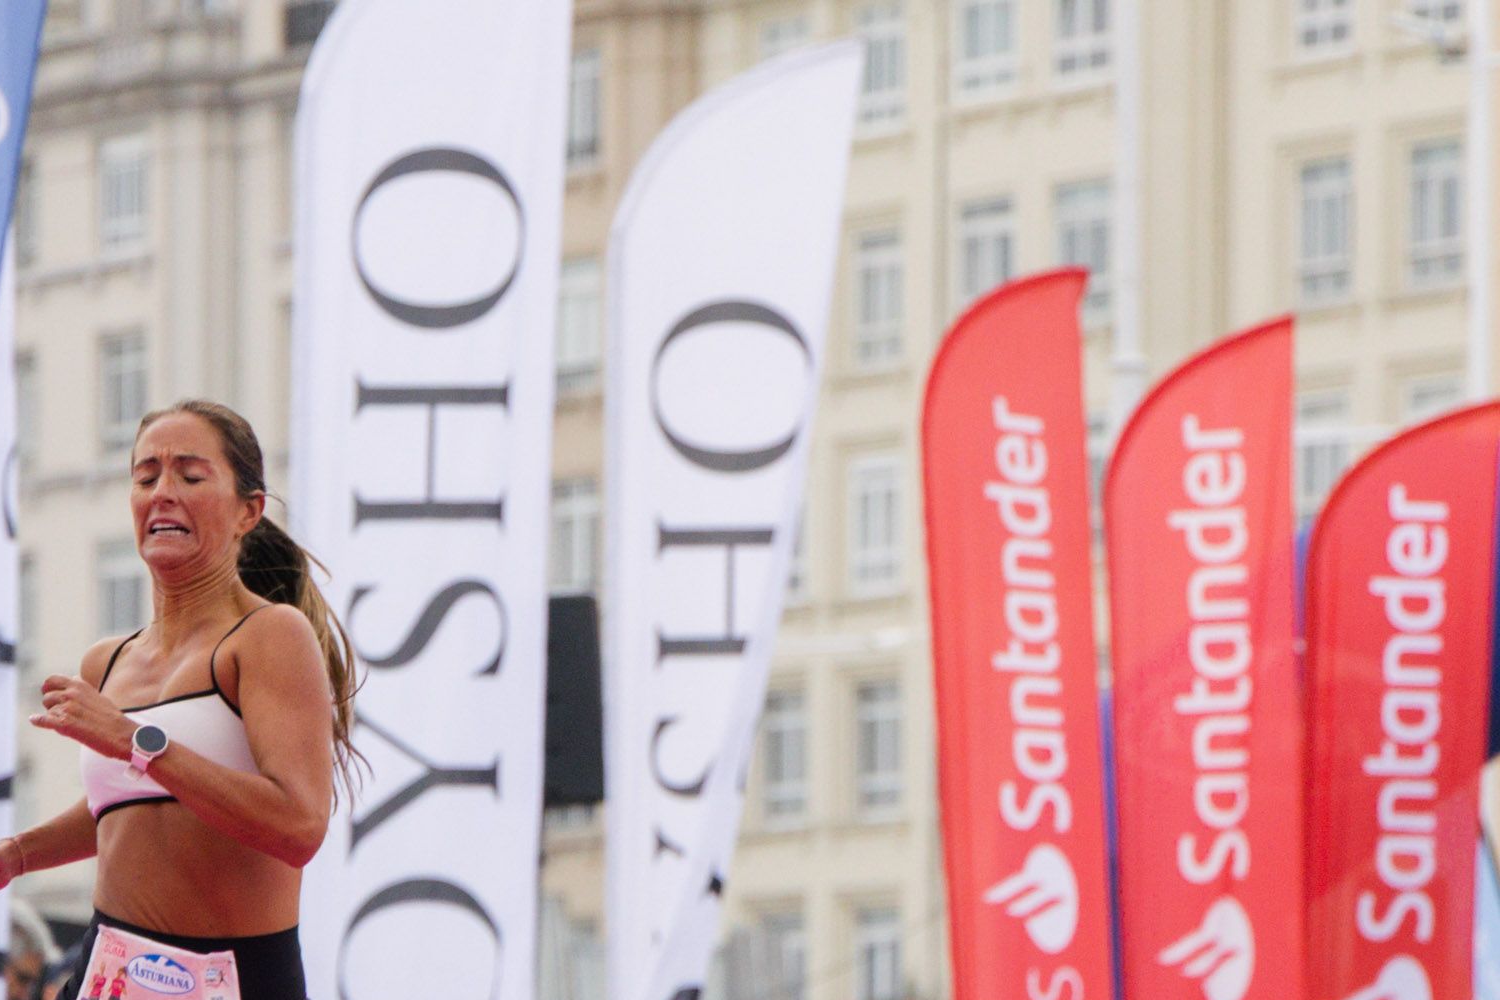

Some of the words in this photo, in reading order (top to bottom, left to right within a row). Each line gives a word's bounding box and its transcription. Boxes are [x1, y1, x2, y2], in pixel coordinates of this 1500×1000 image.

[984, 394, 1073, 833] Santander
[1165, 413, 1254, 887] Santander
[1356, 482, 1450, 943] Santander
[130, 962, 190, 991] ASTURIANA
